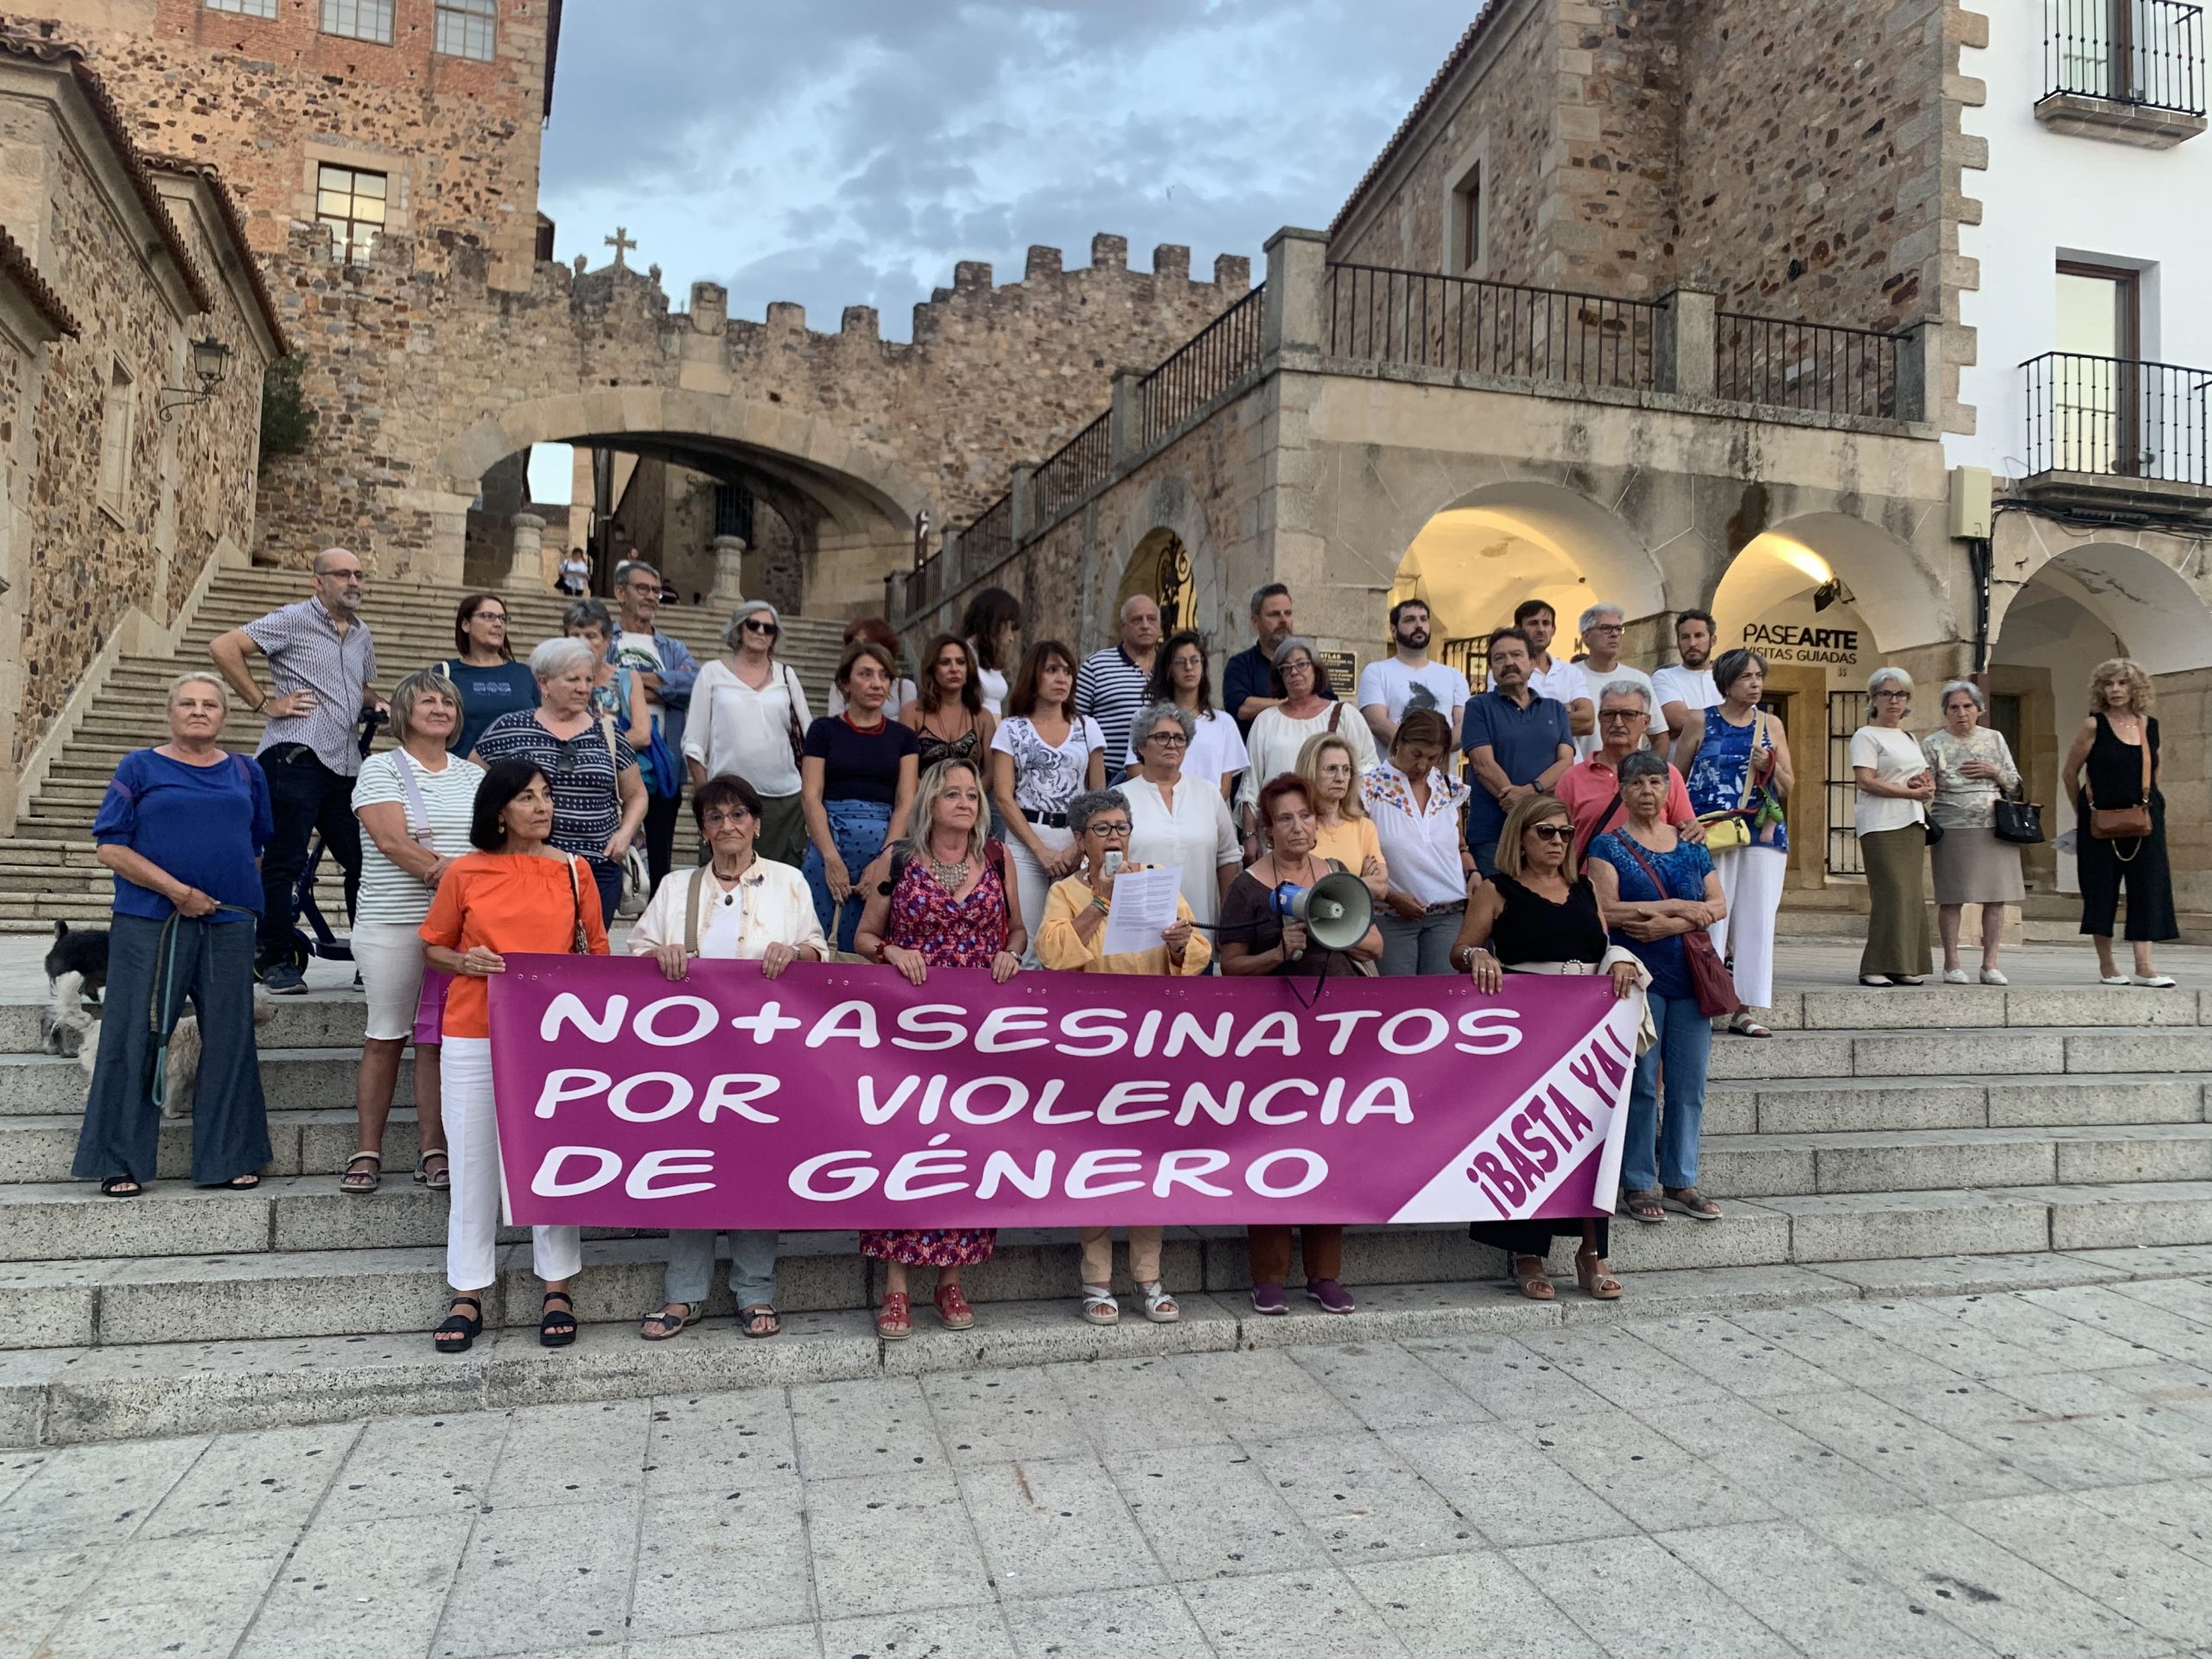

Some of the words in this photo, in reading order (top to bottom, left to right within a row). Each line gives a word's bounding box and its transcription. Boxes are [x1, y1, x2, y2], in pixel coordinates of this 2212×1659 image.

[1743, 623, 1858, 650] PASEARTE
[1796, 649, 1857, 664] GUIADAS
[534, 1068, 781, 1124] POR
[857, 1074, 1414, 1126] VIOLENCIA
[531, 1146, 716, 1199] DE
[788, 1133, 1329, 1202] GÉNERO
